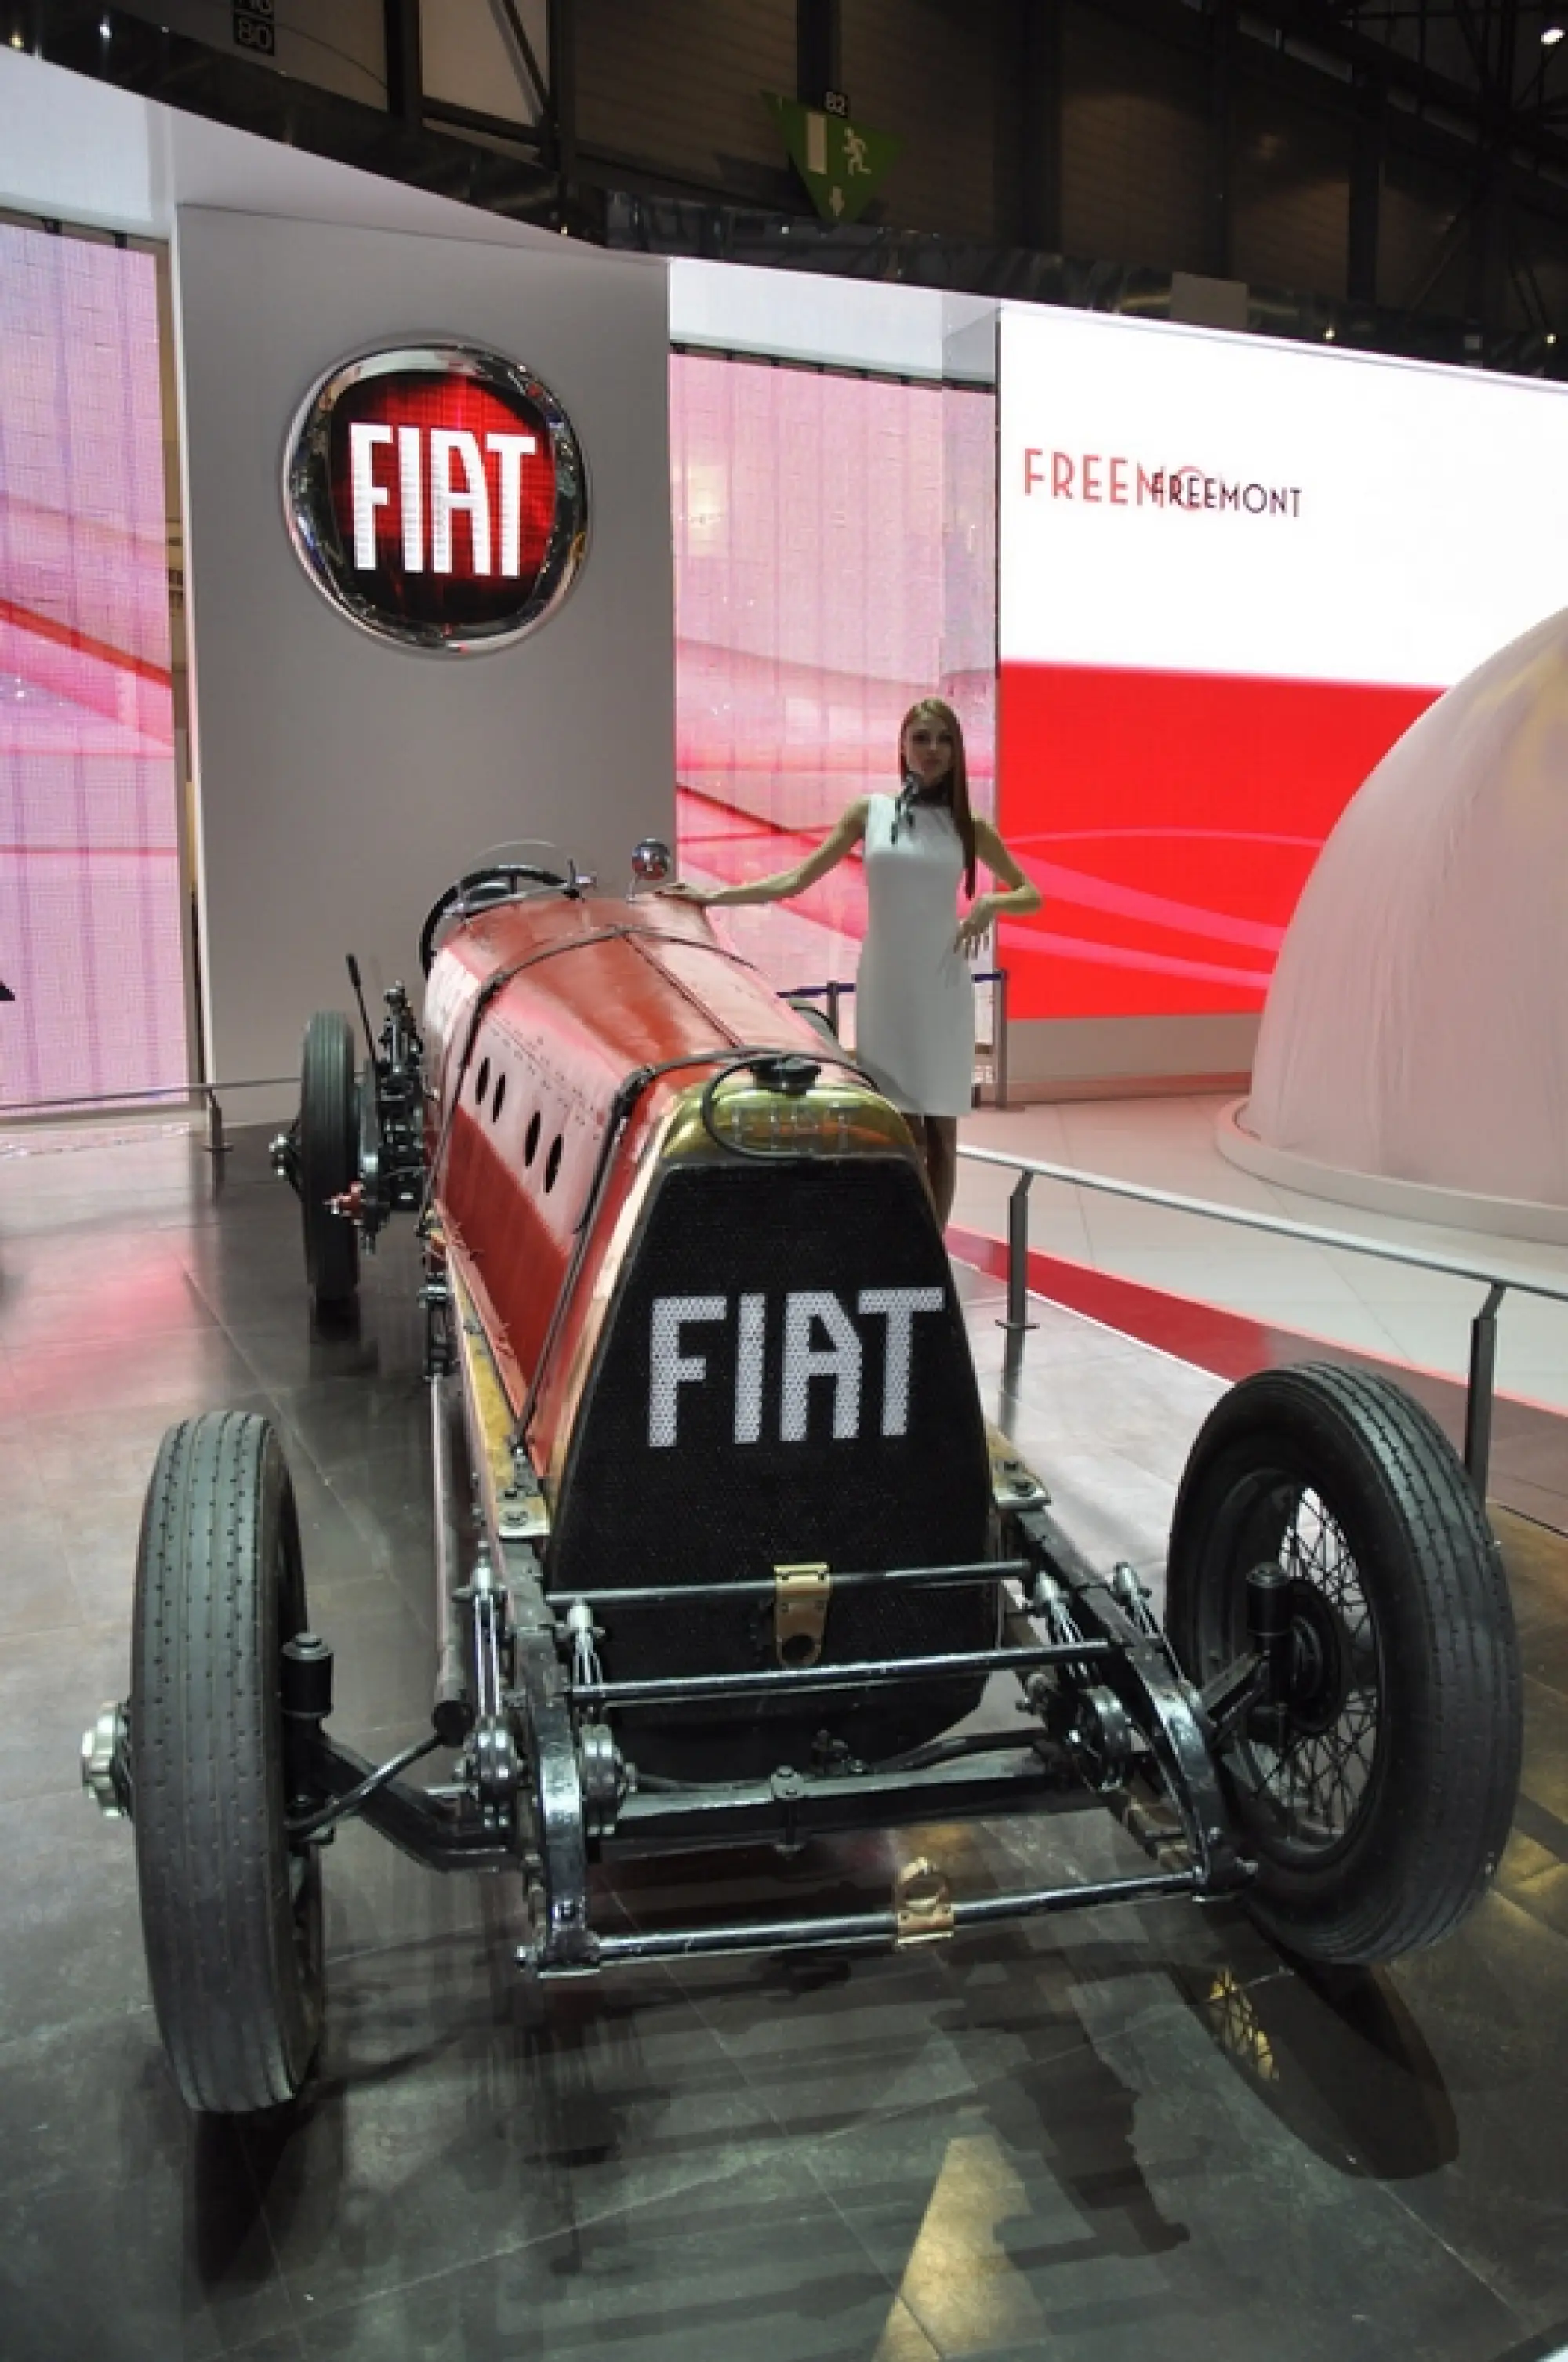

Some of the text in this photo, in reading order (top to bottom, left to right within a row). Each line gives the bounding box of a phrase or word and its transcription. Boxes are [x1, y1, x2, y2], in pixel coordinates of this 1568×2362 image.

[238, 17, 272, 51] 80
[350, 422, 536, 579] FIAT
[1151, 471, 1303, 517] FREEMONT
[648, 1286, 945, 1448] FIAT
